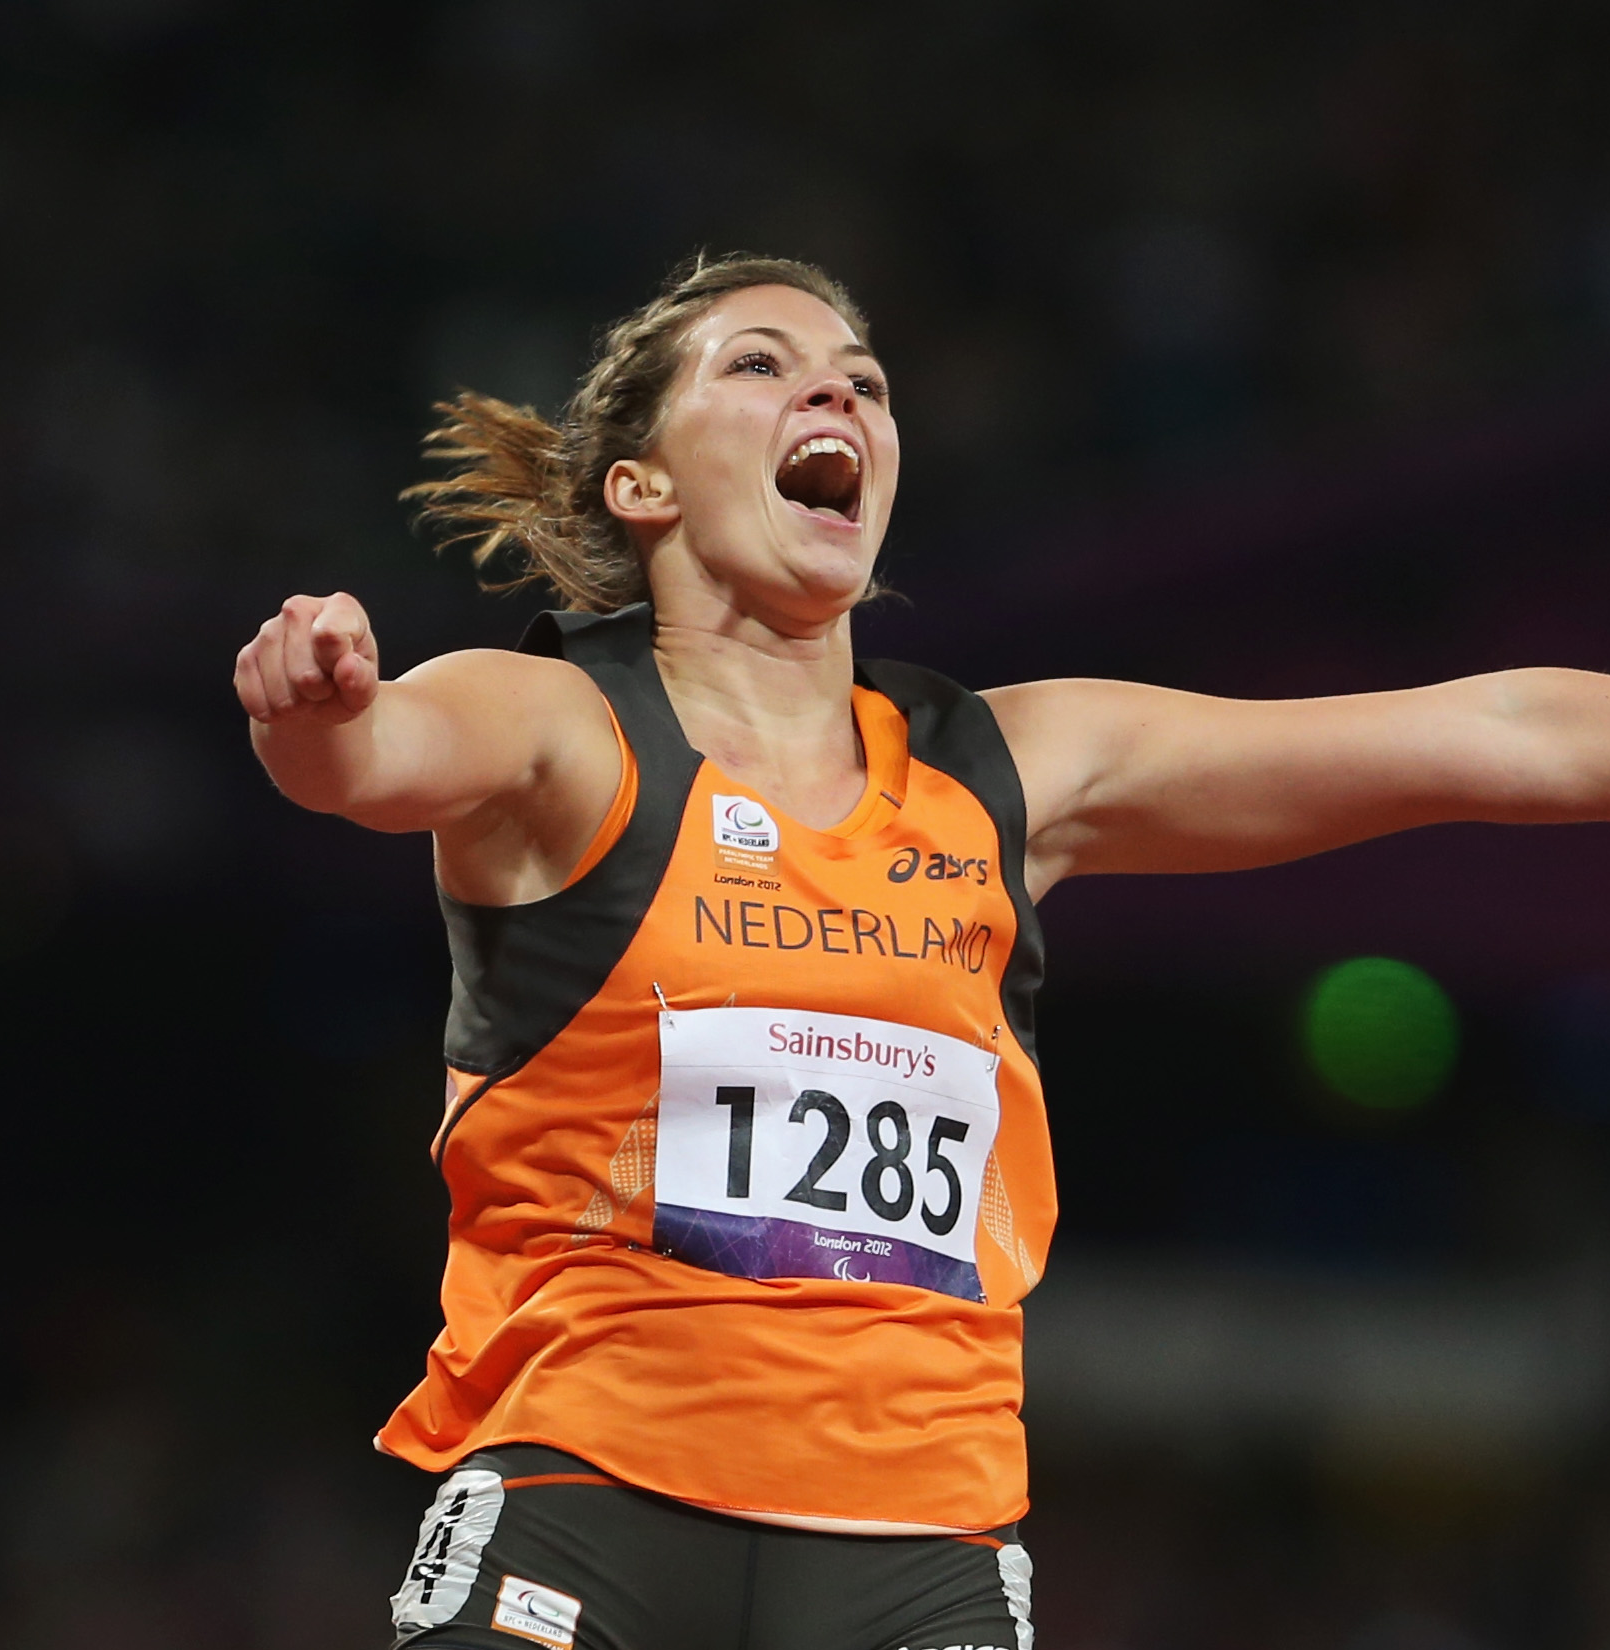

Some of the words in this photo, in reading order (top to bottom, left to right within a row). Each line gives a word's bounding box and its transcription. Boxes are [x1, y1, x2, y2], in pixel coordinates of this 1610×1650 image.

[714, 873, 755, 888] London
[757, 879, 782, 892] 2012
[694, 895, 992, 974] NEDERLAND
[768, 1022, 937, 1079] Sainsbury's
[715, 1085, 970, 1236] 1285
[813, 1231, 862, 1253] London
[863, 1238, 893, 1257] 2012
[503, 1615, 516, 1624] NPC
[524, 1620, 563, 1638] NEDERLAND
